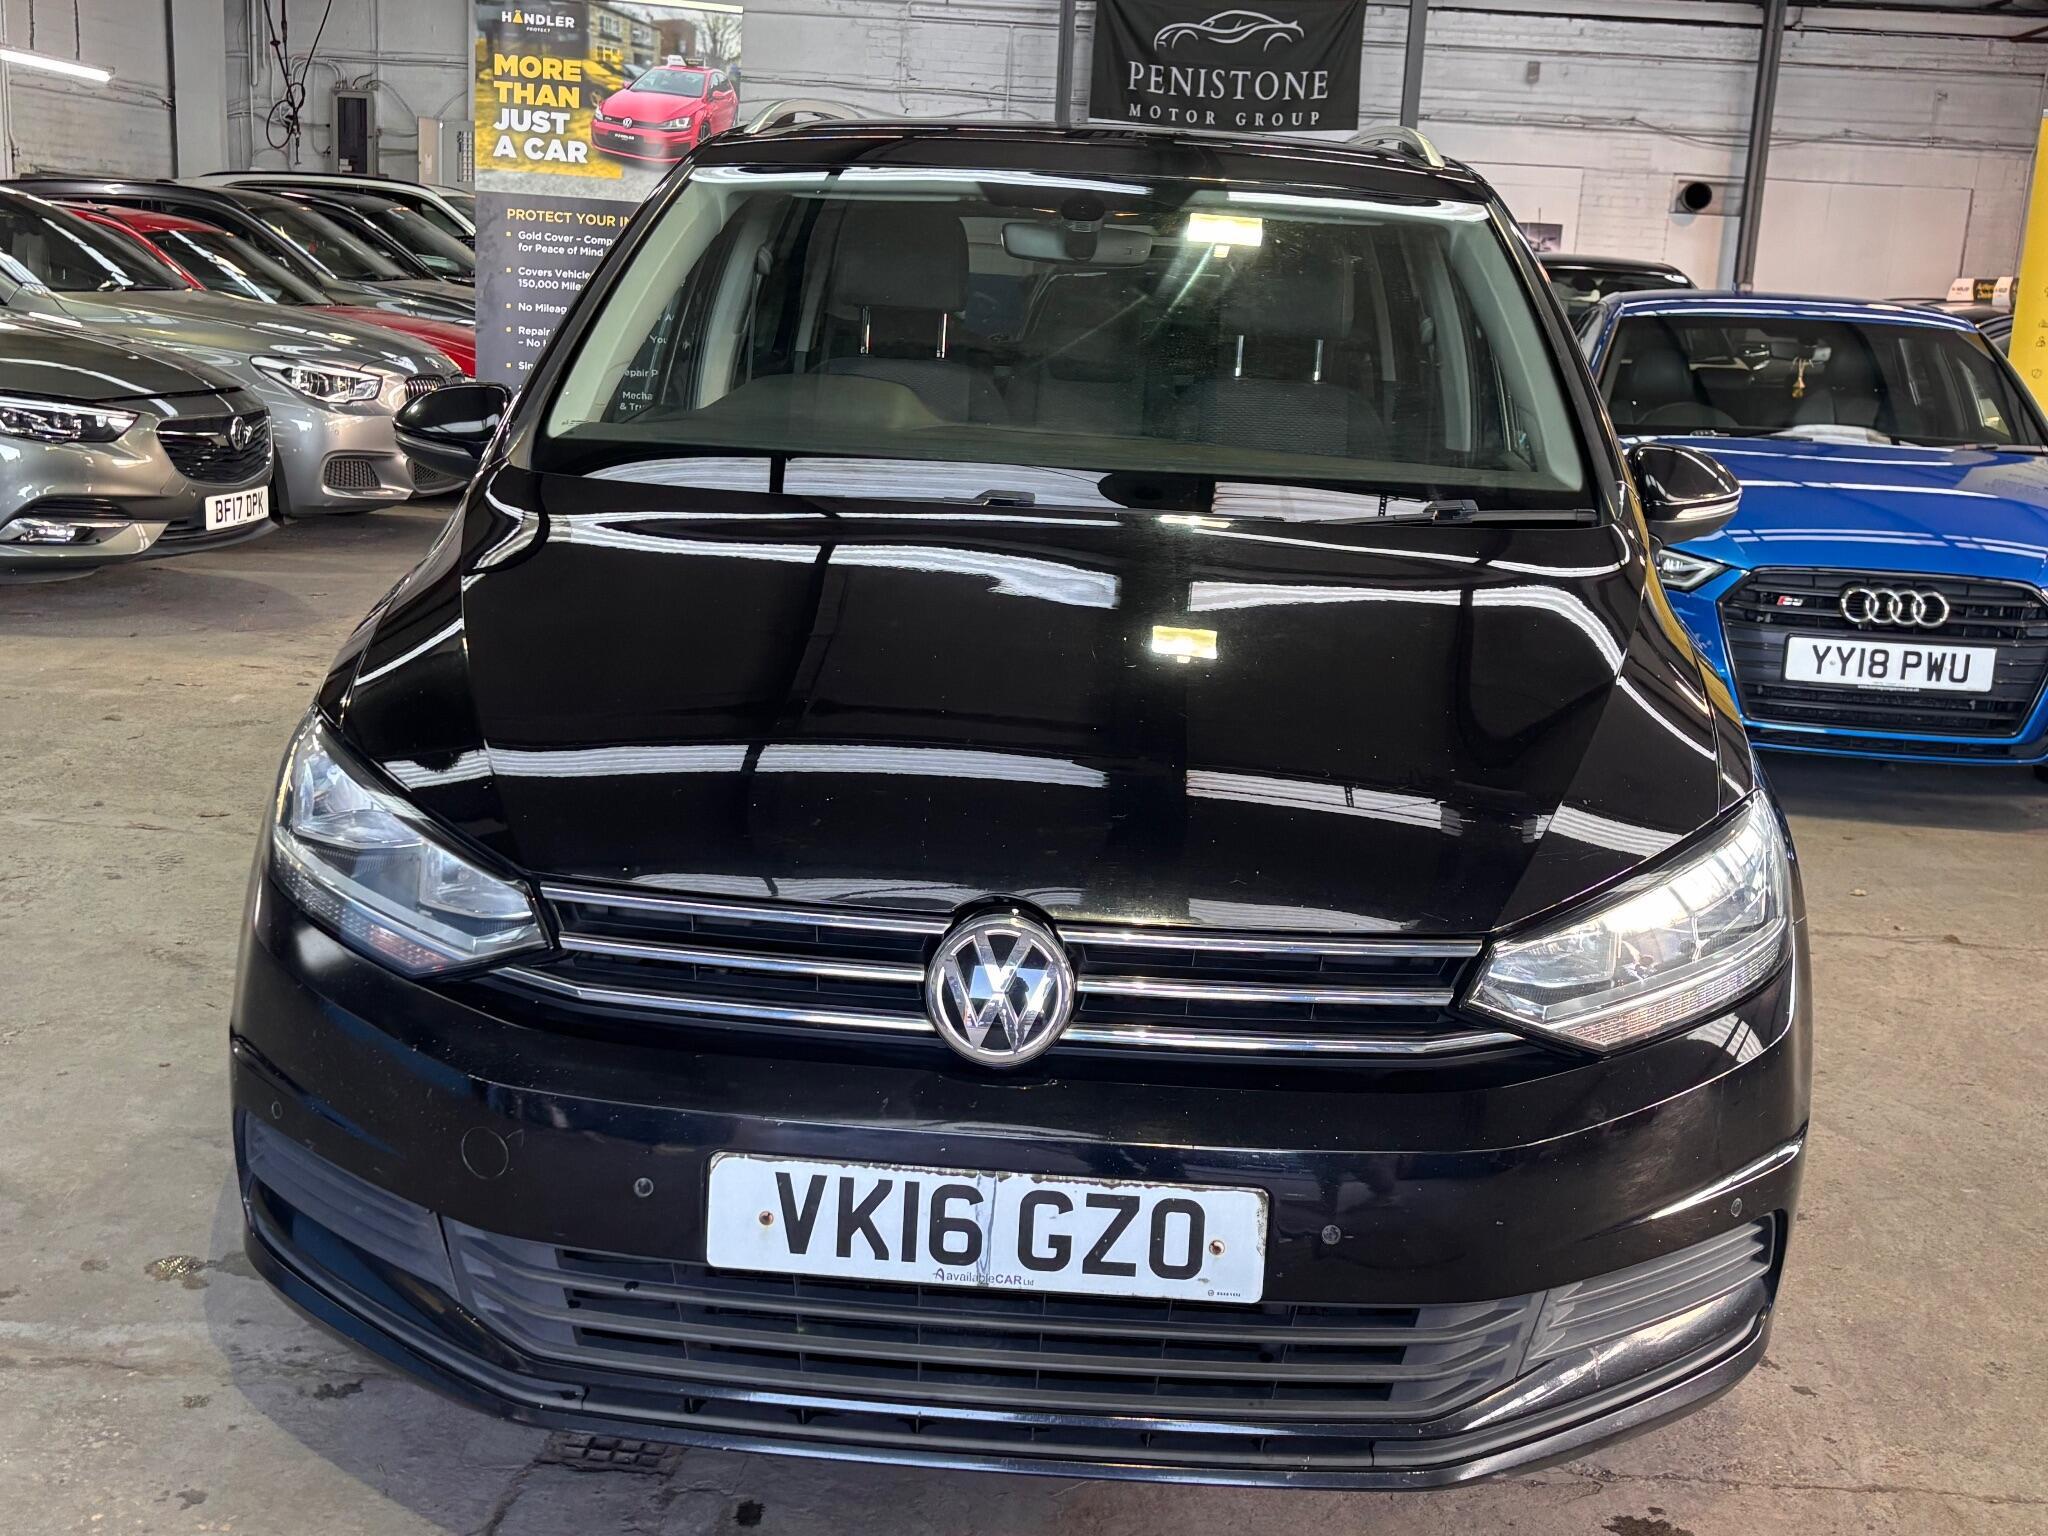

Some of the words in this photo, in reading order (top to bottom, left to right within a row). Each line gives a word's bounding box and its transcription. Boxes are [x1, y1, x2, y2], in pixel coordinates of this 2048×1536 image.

[494, 53, 582, 82] MORE
[1127, 61, 1329, 100] PENISTONE
[493, 81, 580, 109] THAN
[493, 108, 570, 135] JUST
[1128, 103, 1216, 125] MOTOR
[1235, 111, 1320, 126] GROUP
[493, 135, 518, 159] A
[524, 137, 588, 164] CAR
[506, 208, 572, 224] PROTECT
[576, 213, 616, 227] YOUR
[518, 230, 542, 241] Gold
[544, 233, 573, 243] Cover
[518, 243, 533, 252] for
[535, 244, 564, 254] Peace
[567, 245, 578, 255] of
[580, 247, 604, 257] Mind
[518, 267, 552, 278] Covers
[518, 279, 559, 290] 150,000
[561, 281, 583, 291] Mile
[518, 302, 532, 312] No
[535, 303, 567, 315] Mileag
[518, 326, 550, 337] Repair
[526, 338, 541, 347] No
[619, 402, 627, 410] &
[215, 496, 243, 524] BF17
[246, 491, 264, 518] DPK
[1812, 644, 1890, 679] YY18
[1900, 650, 1972, 683] PWU
[774, 1171, 985, 1268] VK16
[1017, 1189, 1207, 1281] GZO
